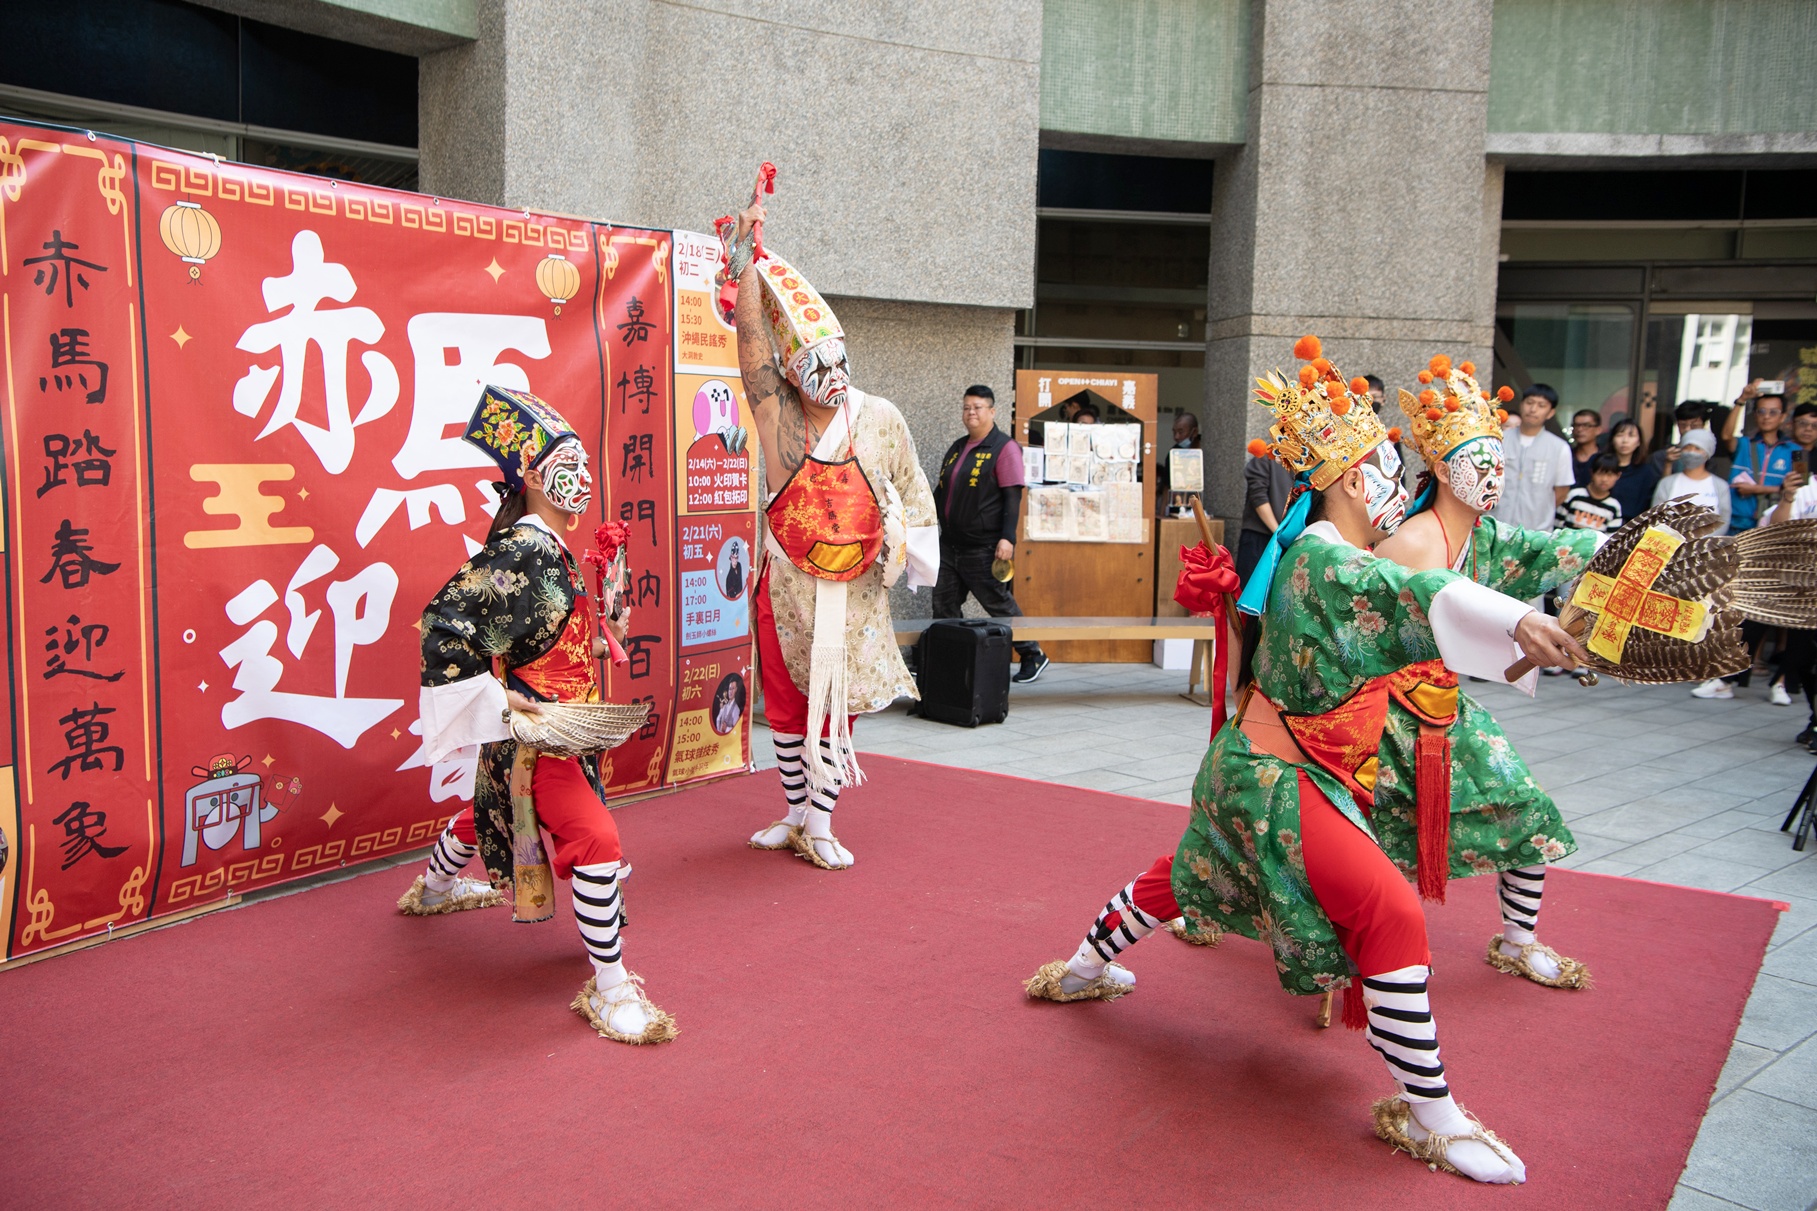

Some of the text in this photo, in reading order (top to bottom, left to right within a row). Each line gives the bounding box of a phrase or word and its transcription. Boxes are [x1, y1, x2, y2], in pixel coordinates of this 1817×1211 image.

[678, 242, 721, 264] 2/18(三)
[679, 260, 700, 277] 初二
[680, 295, 703, 307] 14:00
[774, 266, 818, 320] 一見大吉
[680, 314, 703, 326] 15:30
[681, 330, 728, 349] 沖繩民謠秀
[688, 472, 748, 488] 10:00 火印賀卡
[688, 490, 748, 505] 12:00 紅包拓印
[682, 523, 723, 543] 2/21(六)
[23, 230, 132, 871] 赤馬踏春迎萬象
[683, 544, 704, 560] 初五
[685, 576, 707, 588] 14:00
[685, 594, 707, 606] 17:00
[685, 609, 721, 627] 手裏日月
[683, 662, 721, 684] 2/22(日)
[681, 684, 703, 701] 初六
[679, 715, 703, 728] 14:00
[677, 732, 701, 745] 15:00
